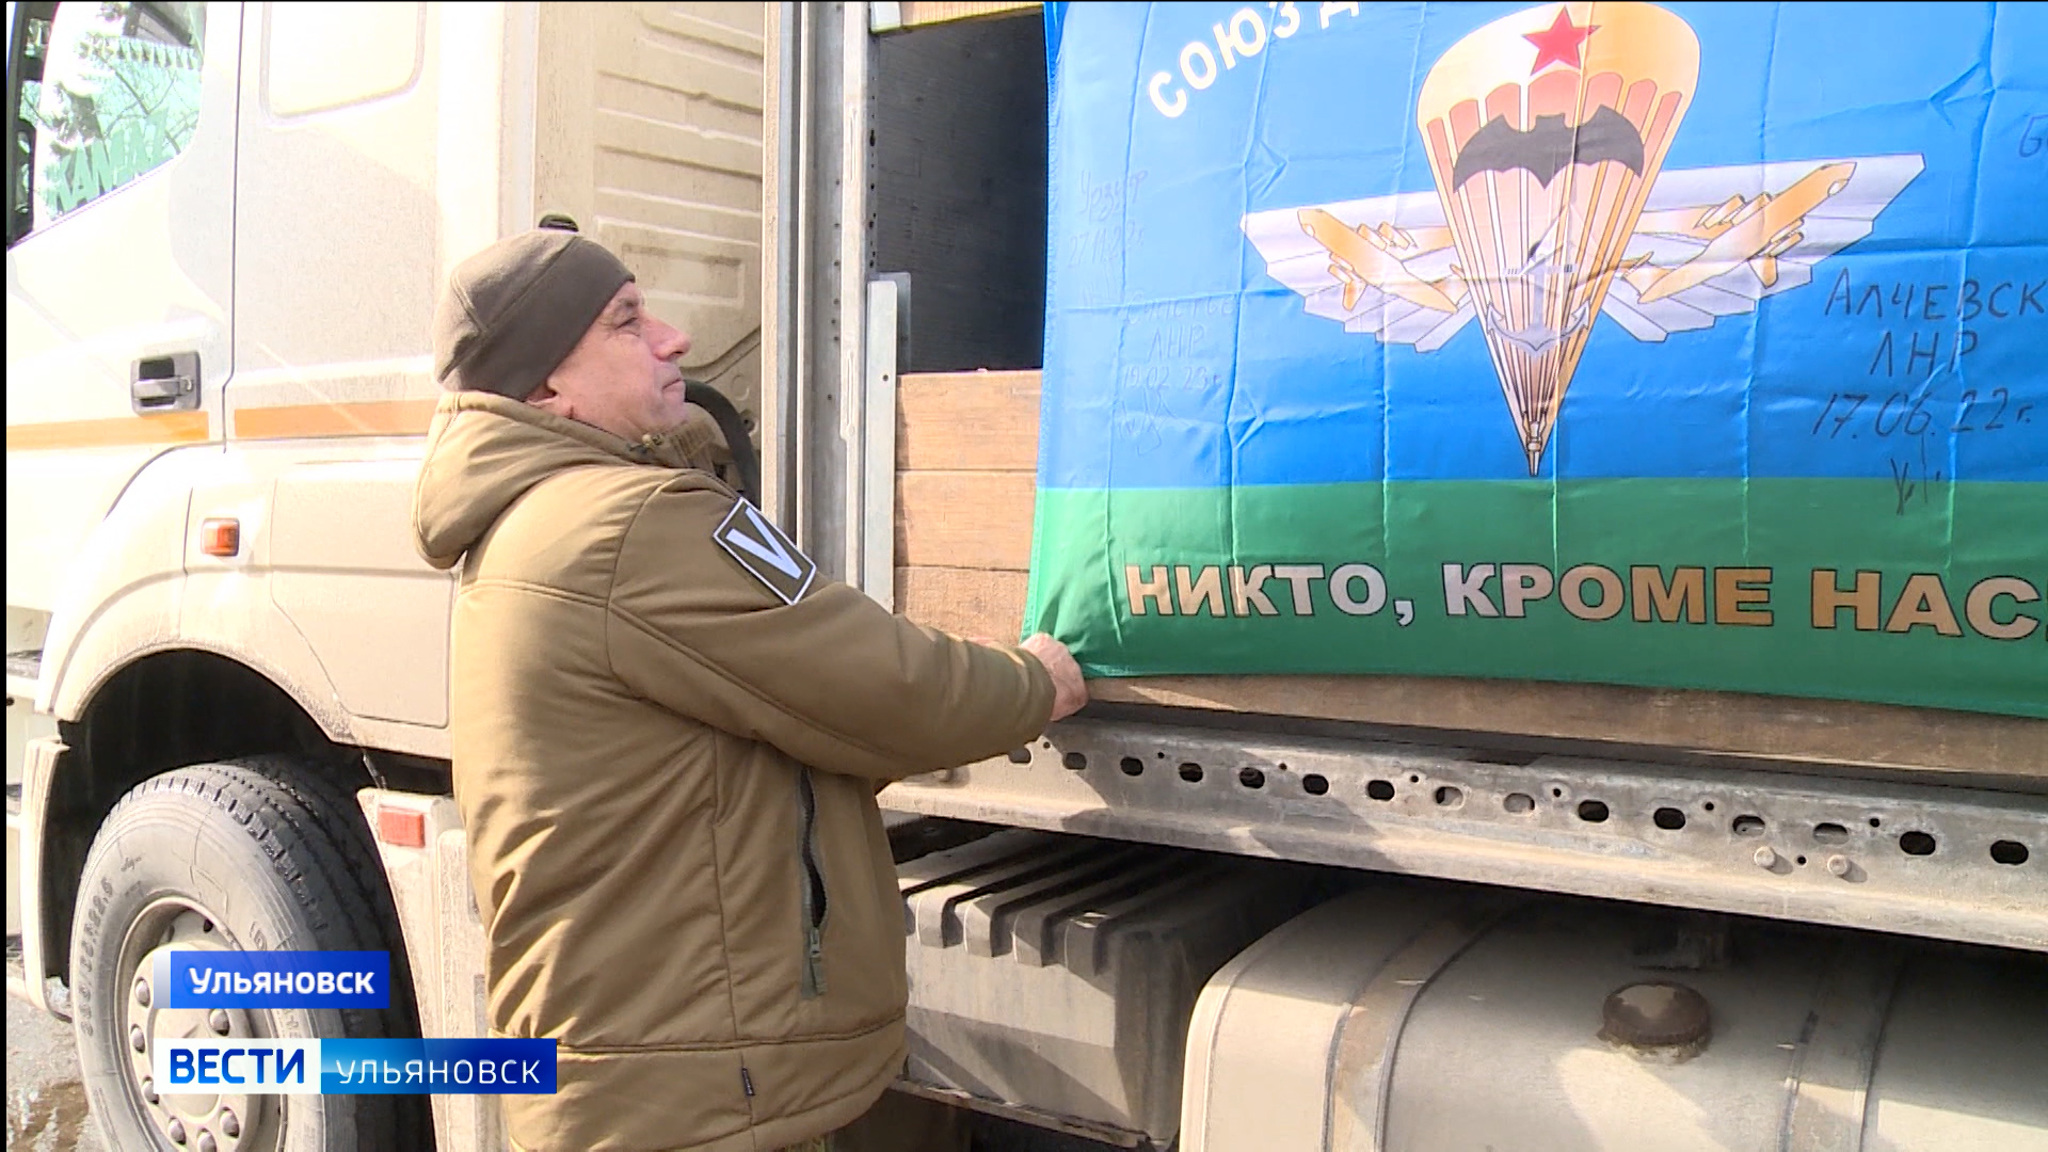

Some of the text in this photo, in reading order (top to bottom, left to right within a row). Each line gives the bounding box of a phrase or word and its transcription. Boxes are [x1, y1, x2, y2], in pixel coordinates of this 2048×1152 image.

[1148, 2, 1301, 118] СОЮЗ
[1824, 266, 2047, 321] АЛЧЕВСК
[1869, 330, 1979, 377] ЛНР
[725, 506, 803, 580] V
[1124, 562, 2048, 641] НИКТО, КРОМЕ НАС
